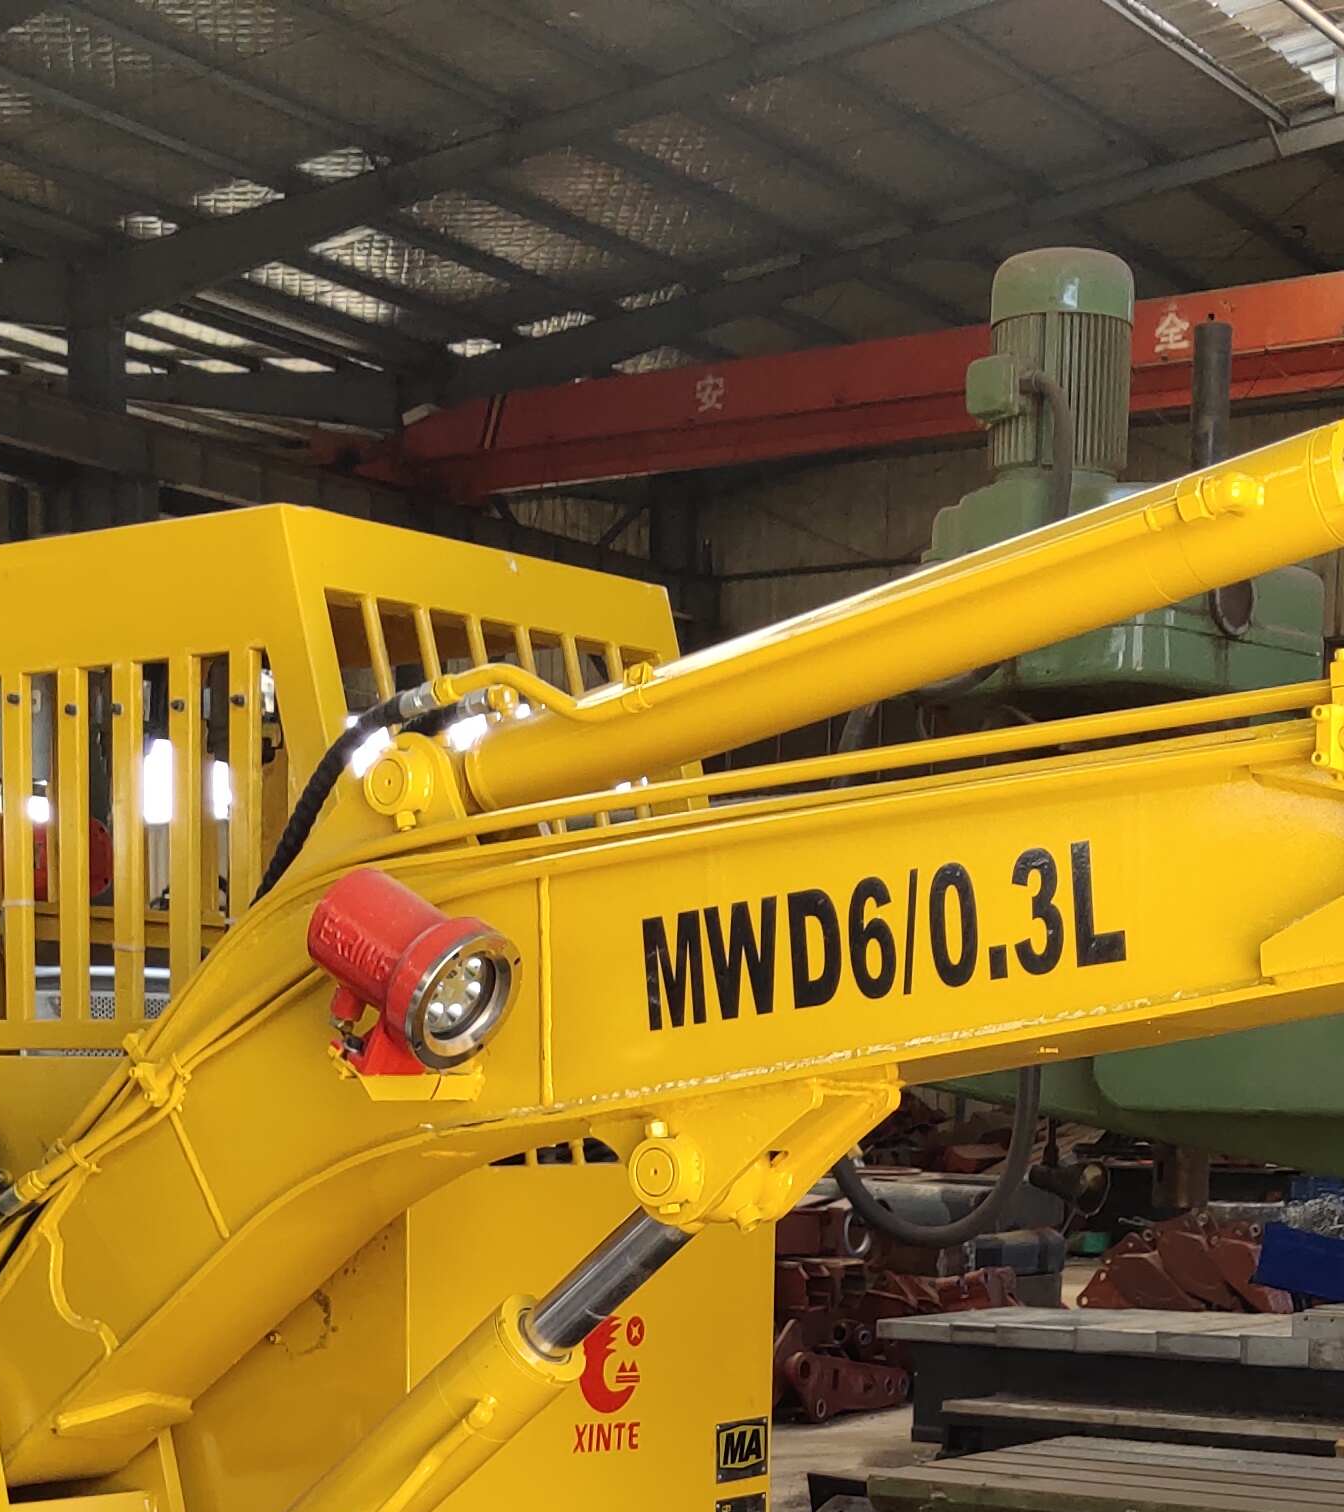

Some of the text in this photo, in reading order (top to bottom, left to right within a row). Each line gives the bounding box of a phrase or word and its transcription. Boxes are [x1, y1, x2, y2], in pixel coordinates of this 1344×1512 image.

[1154, 304, 1189, 352] 全
[642, 840, 1127, 1031] MWD6/0.3L
[573, 1422, 640, 1454] XINTE
[722, 1428, 763, 1466] MA
